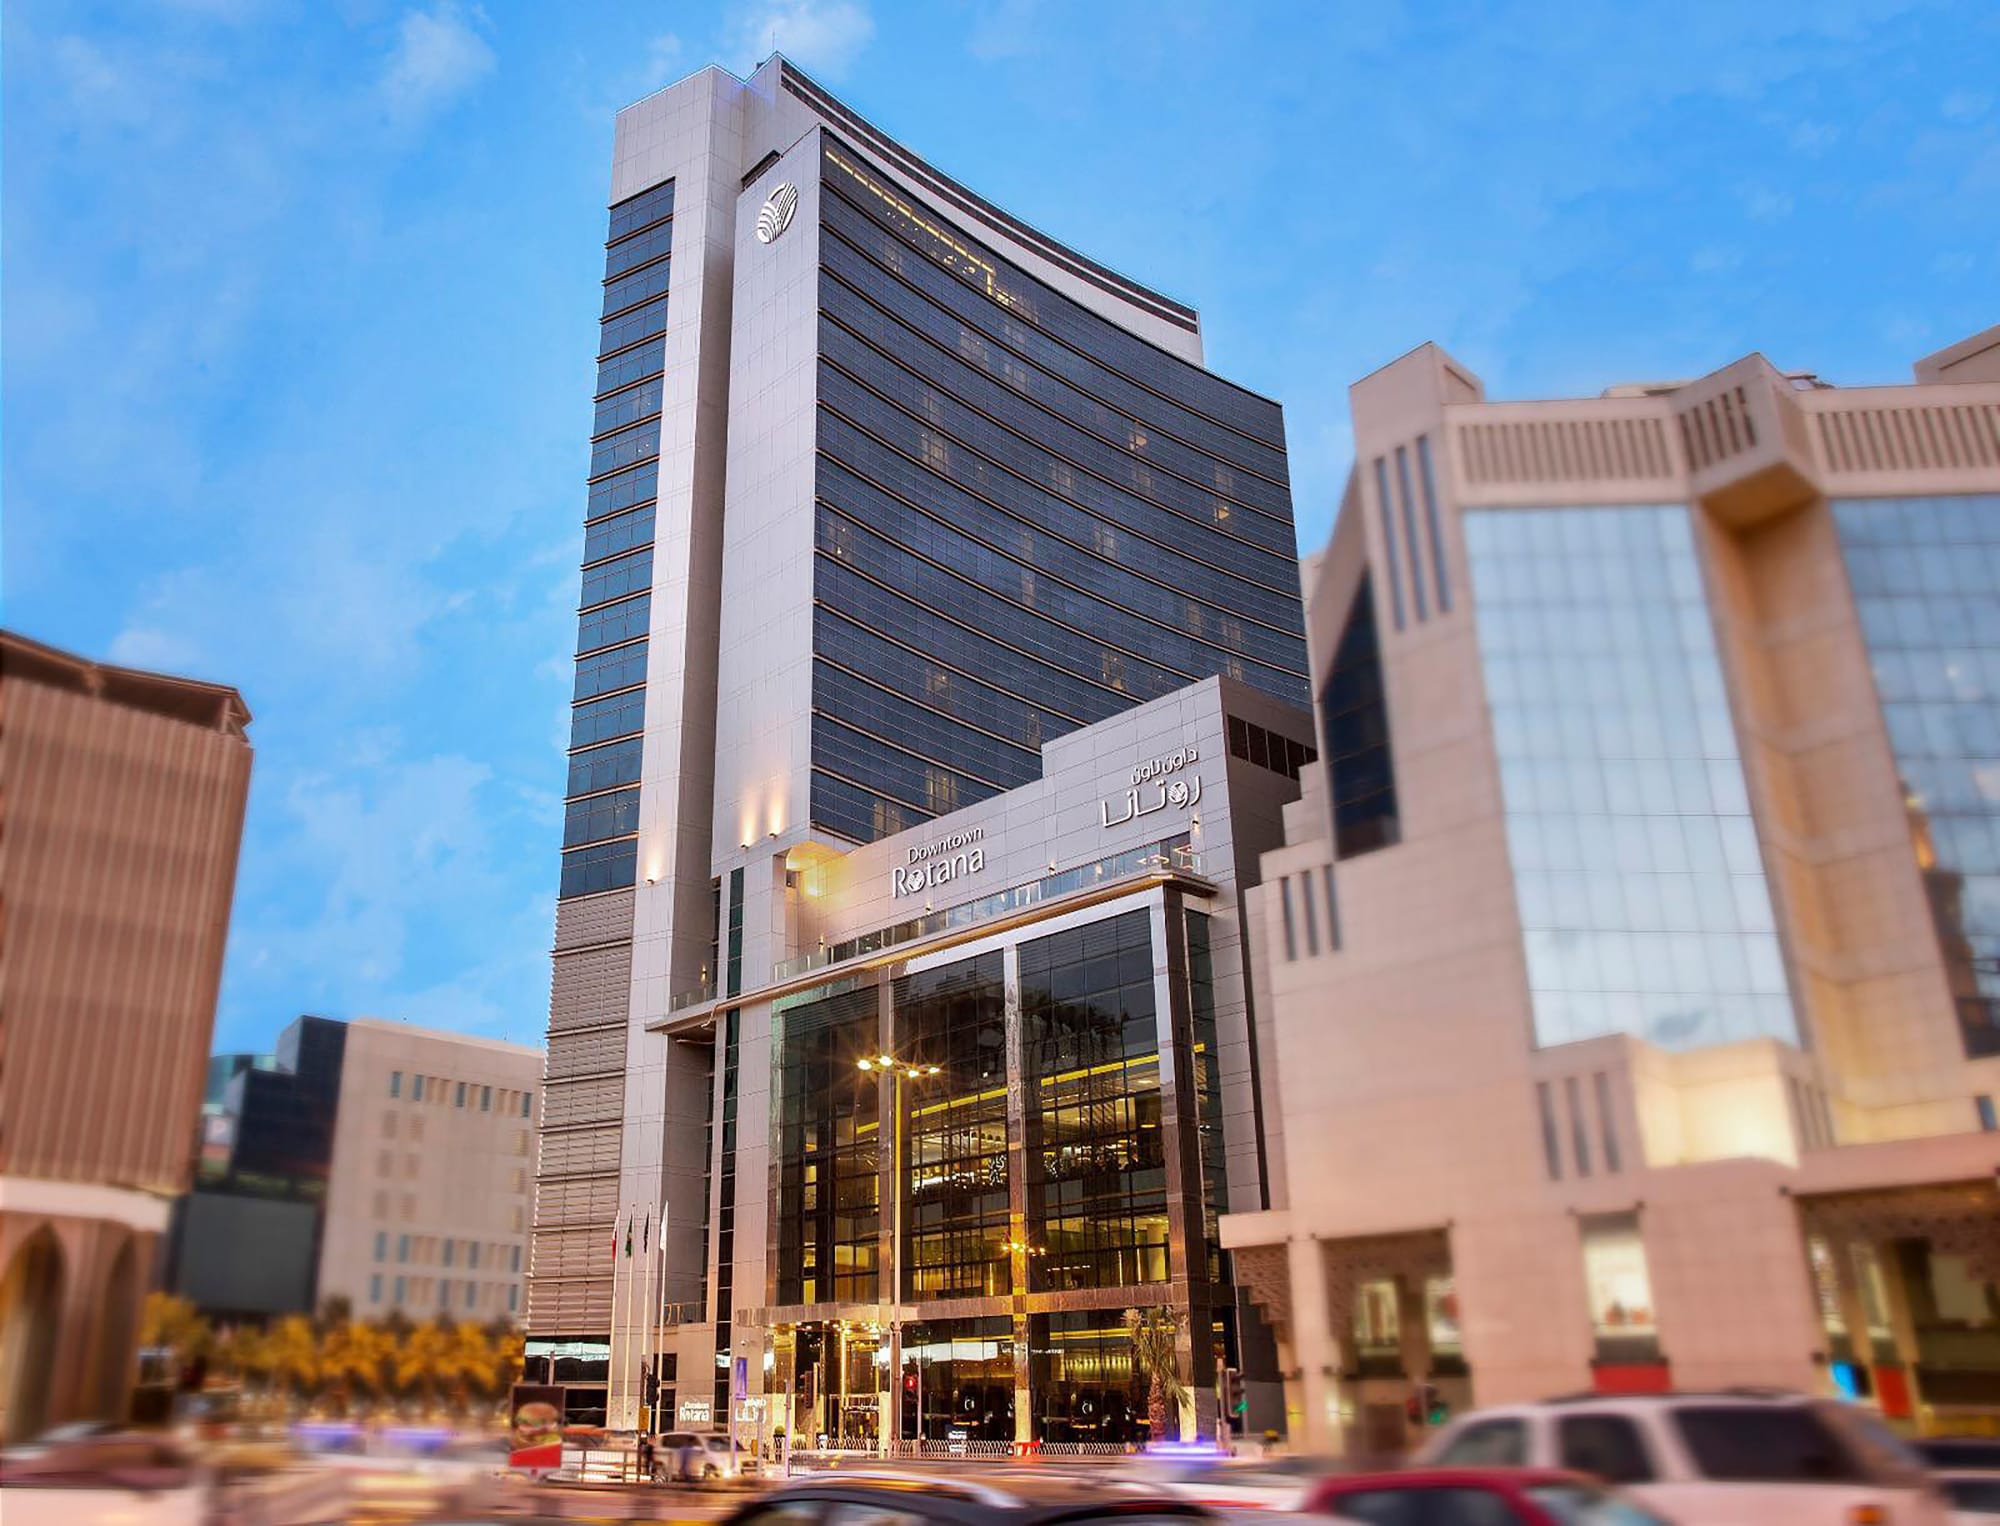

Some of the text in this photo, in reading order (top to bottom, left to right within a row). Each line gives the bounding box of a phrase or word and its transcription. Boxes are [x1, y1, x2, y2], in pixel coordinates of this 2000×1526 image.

[1102, 775, 1202, 828] روتانا
[907, 827, 984, 865] Downtown
[892, 848, 985, 899] Rotana
